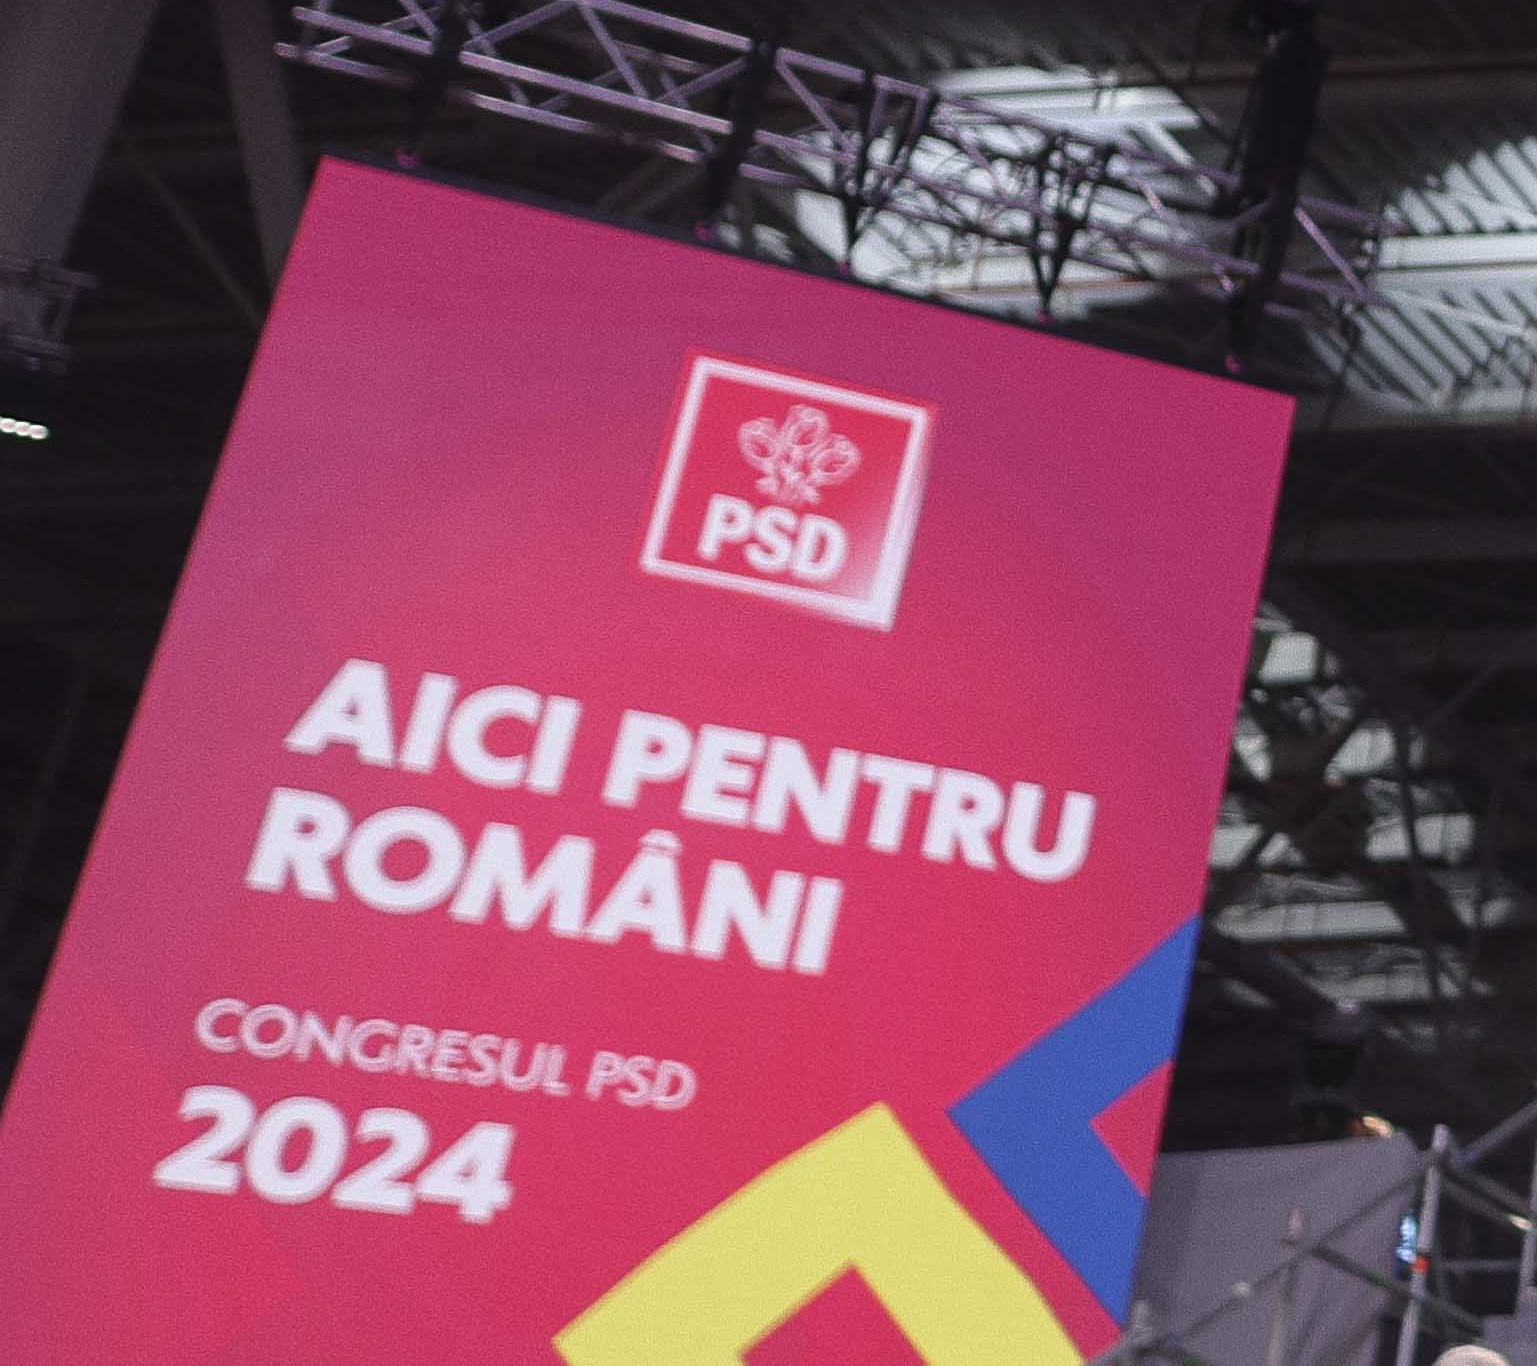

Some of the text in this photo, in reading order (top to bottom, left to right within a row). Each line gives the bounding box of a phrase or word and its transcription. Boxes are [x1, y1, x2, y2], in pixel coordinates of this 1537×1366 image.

[698, 496, 848, 583] PSD
[285, 659, 1096, 882] AICI PENTRU
[246, 788, 843, 975] ROMÂNI
[194, 998, 697, 1112] CONGRESUL PSD
[154, 1087, 514, 1223] 2024
